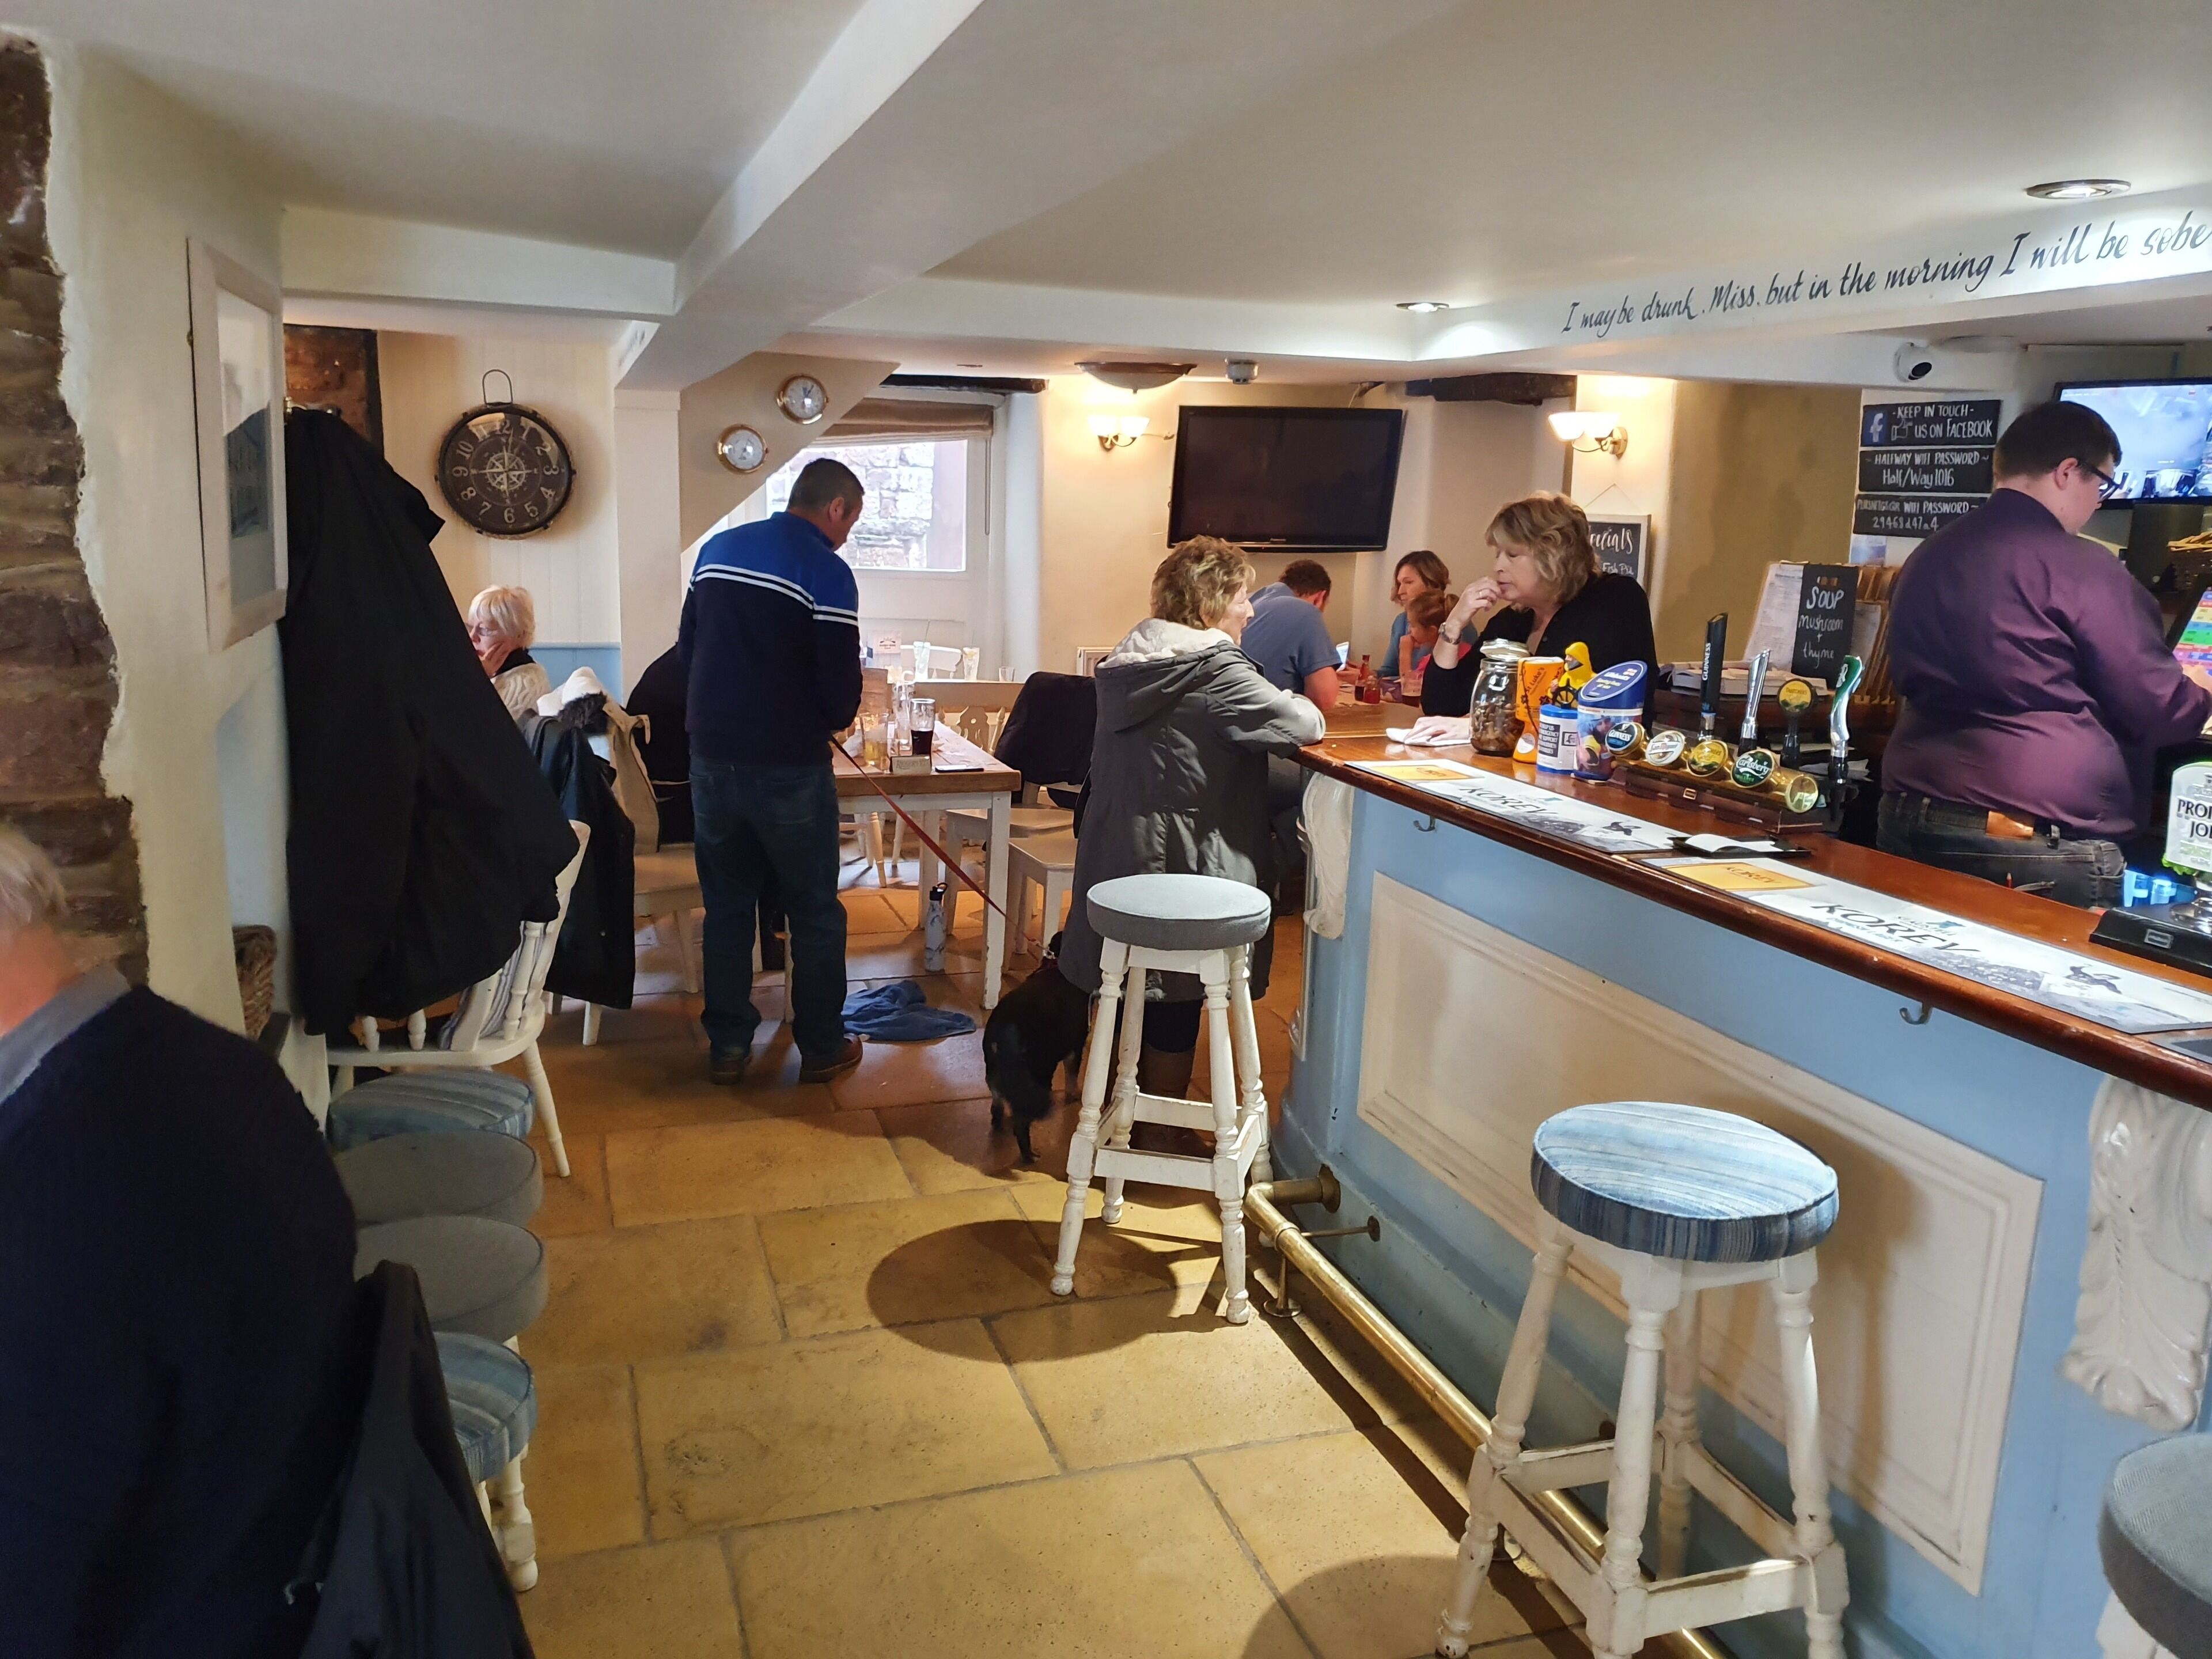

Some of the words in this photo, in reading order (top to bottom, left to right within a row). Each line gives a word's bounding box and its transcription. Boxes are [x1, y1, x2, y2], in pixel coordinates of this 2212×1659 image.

[1561, 302, 1581, 334] I
[1766, 270, 1805, 305] but
[1809, 275, 1832, 298] in
[1839, 262, 1877, 295] the
[1884, 252, 1994, 292] morning
[1999, 232, 2031, 276] I
[2029, 223, 2093, 270] will
[2096, 220, 2128, 260] be
[1924, 404, 1935, 418] IN
[1915, 424, 1927, 438] US
[1930, 424, 1943, 438] ON
[1946, 418, 1993, 438] FACEBOOK
[1874, 452, 1911, 465] HALFWAY
[1935, 452, 1979, 465] PASSWORD
[1923, 501, 1969, 514] PASSWORD
[1798, 614, 1843, 631] mushroom
[1702, 642, 1711, 681] GUINNESS
[1803, 641, 1835, 668] thyme
[1736, 755, 1771, 775] Carlsberg
[1459, 788, 1558, 814] KOREV
[2177, 798, 2212, 819] PRO
[2190, 821, 2212, 838] JO
[1810, 904, 1981, 952] KOREV
